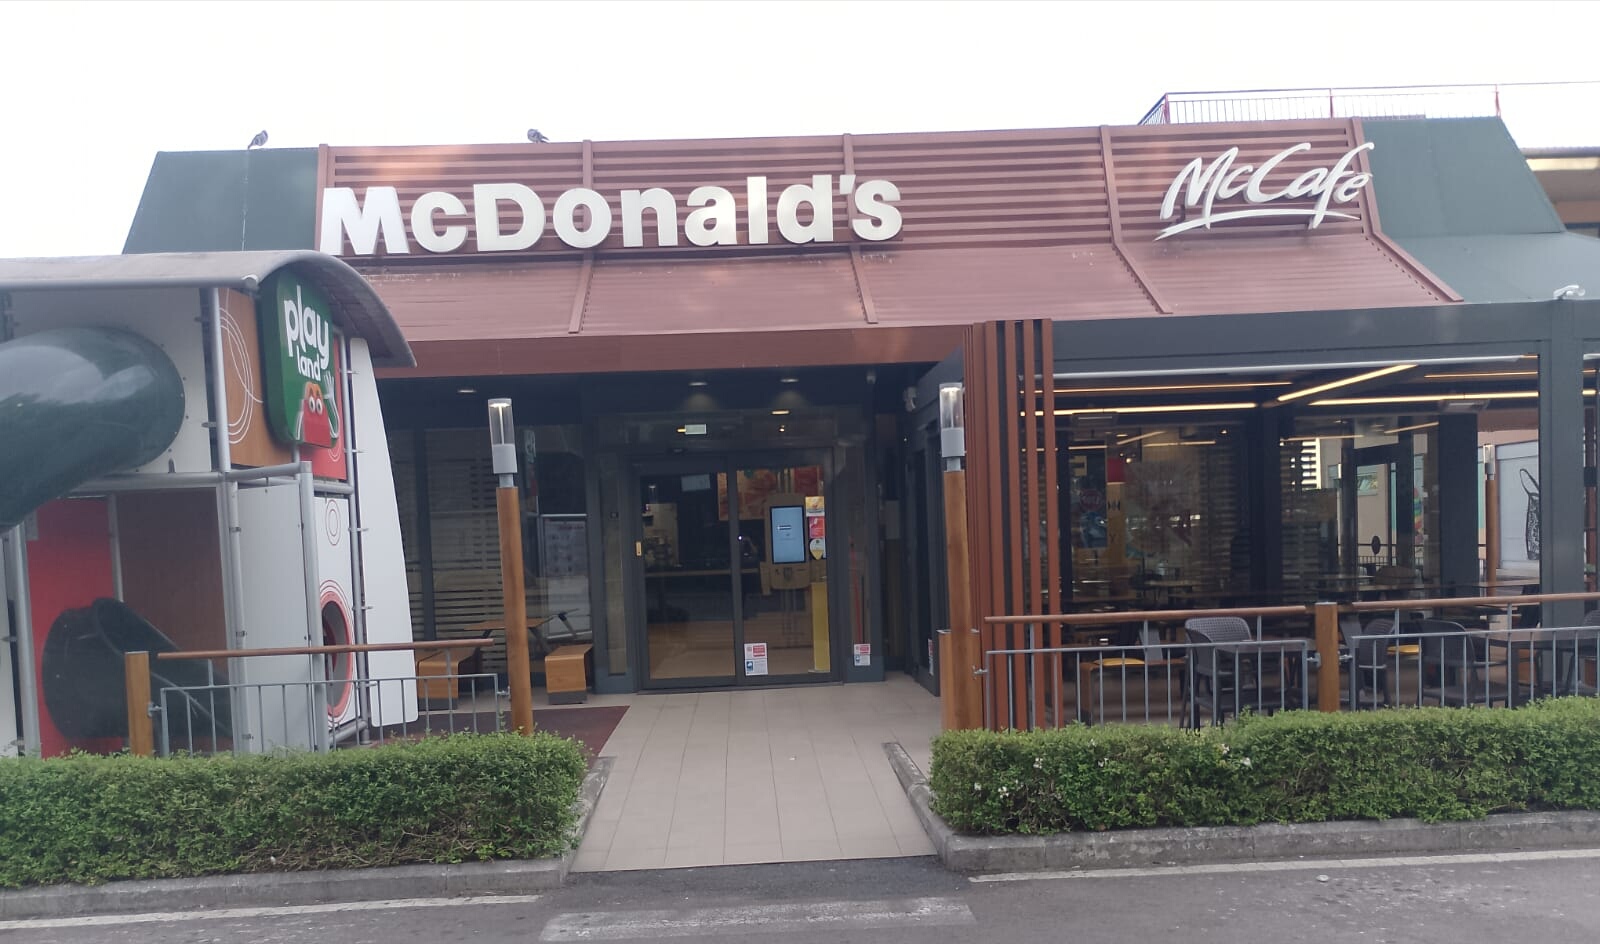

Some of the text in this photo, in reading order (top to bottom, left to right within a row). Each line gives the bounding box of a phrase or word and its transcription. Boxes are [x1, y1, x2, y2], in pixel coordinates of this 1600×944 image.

[320, 174, 903, 256] McDonald's
[283, 284, 330, 370] play
[296, 345, 321, 382] land
